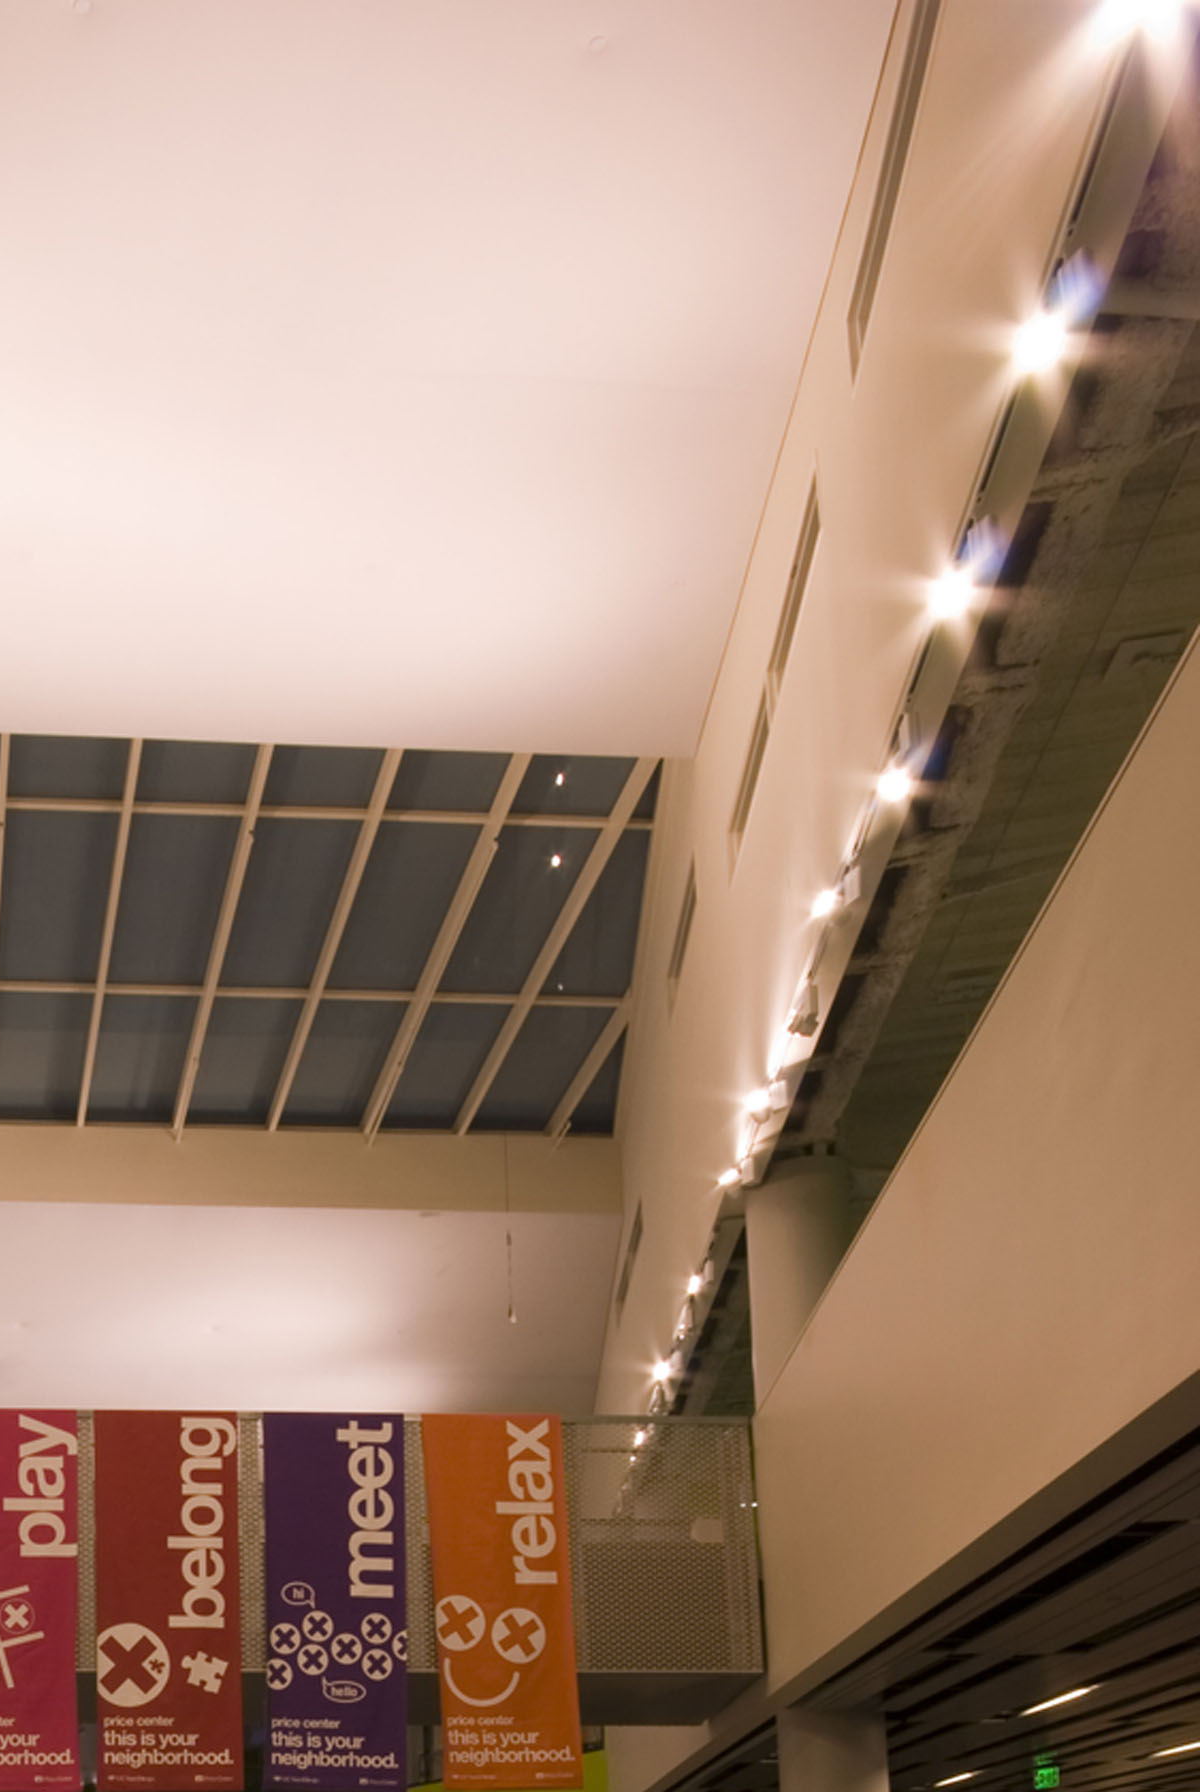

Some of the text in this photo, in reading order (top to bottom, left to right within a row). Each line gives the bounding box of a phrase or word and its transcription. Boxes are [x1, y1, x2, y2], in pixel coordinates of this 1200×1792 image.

[3, 1414, 77, 1557] play
[337, 1421, 393, 1598] meet
[496, 1419, 557, 1584] relax
[168, 1417, 236, 1628] belong
[331, 1686, 358, 1698] hello
[104, 1716, 174, 1727] price center
[272, 1718, 340, 1728] price center
[447, 1716, 513, 1726] price center
[0, 1734, 40, 1749] your
[104, 1730, 199, 1748] this is your
[271, 1731, 364, 1751] this is your
[448, 1730, 539, 1747] this is your
[104, 1749, 233, 1768] neighborhood.
[272, 1751, 398, 1769] neighborhood.
[449, 1747, 575, 1766] neighborhood.
